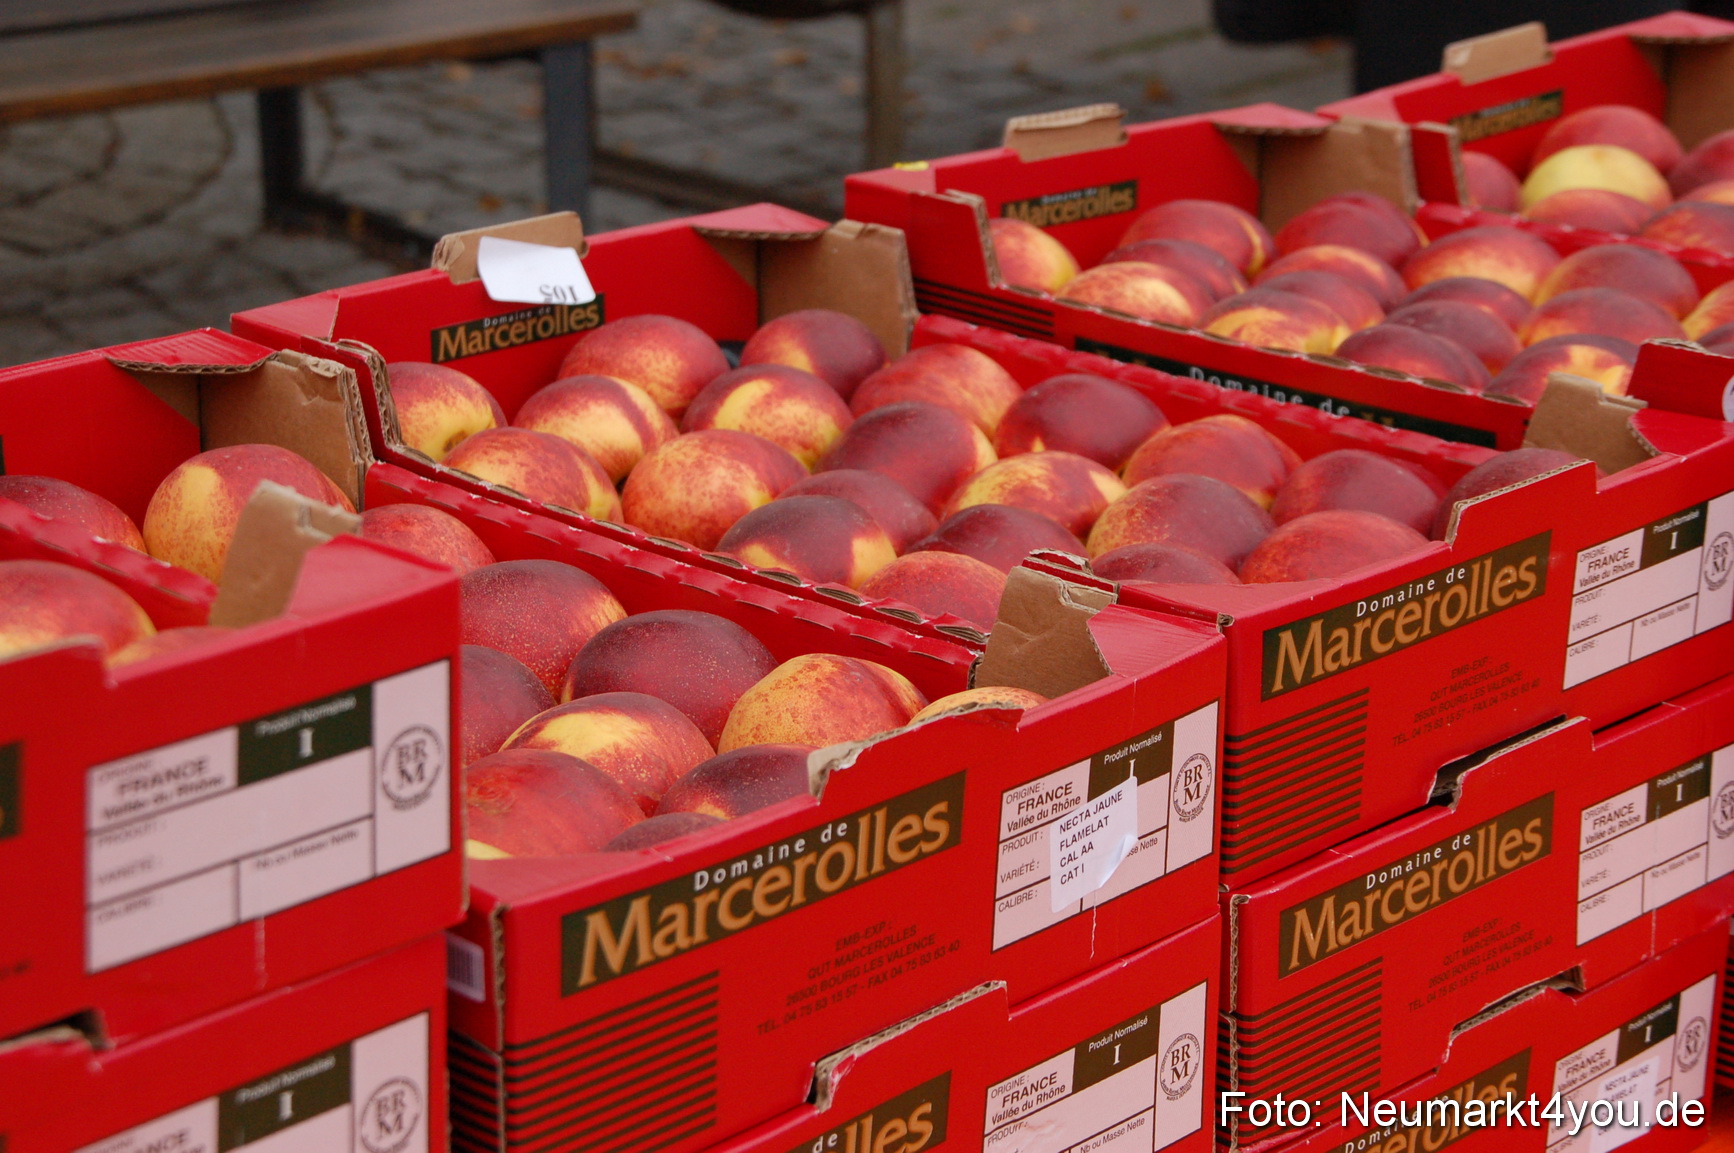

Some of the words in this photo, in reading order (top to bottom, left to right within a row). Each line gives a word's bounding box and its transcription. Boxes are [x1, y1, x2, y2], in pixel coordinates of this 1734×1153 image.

[438, 304, 600, 362] Marcerolles
[484, 311, 532, 328] Domaine
[1579, 573, 1600, 588] Vallée
[1602, 568, 1612, 581] du
[1612, 560, 1635, 576] Rhône
[1587, 547, 1630, 574] FRANCE
[1356, 578, 1436, 617] Domaine
[1446, 566, 1466, 584] de
[1271, 555, 1538, 693] Marcerolles
[1450, 662, 1511, 693] MARCEROLLES
[1104, 746, 1129, 765] Produit
[1129, 731, 1162, 754] Normalisé
[1183, 764, 1203, 788] BR
[1018, 782, 1073, 815] FRANCE
[1182, 781, 1202, 806] M
[1007, 815, 1034, 833] Vallée
[1036, 808, 1049, 821] du
[1051, 795, 1081, 815] Rhône
[1060, 809, 1091, 834] NECTA
[1093, 790, 1123, 815] JAUNE
[1592, 802, 1635, 830] FRANCE
[1060, 816, 1109, 851] FLAMELAT
[1140, 837, 1158, 850] Nette
[1607, 824, 1617, 836] du
[694, 837, 806, 891] Domaine
[820, 821, 848, 844] de
[1060, 852, 1078, 868] CAL
[1081, 841, 1094, 857] AA
[1366, 845, 1442, 890] Domaine
[1452, 833, 1471, 850] de
[1060, 867, 1080, 885] CAT
[578, 801, 949, 987] Marcerolles
[1288, 817, 1544, 970] Marcerolles
[807, 961, 831, 979] QUT
[834, 925, 917, 969] MARCEROLLES
[820, 968, 861, 995] BOURG
[863, 957, 884, 974] LES
[887, 933, 937, 964] VALENCE
[868, 971, 889, 989] FAX
[890, 965, 903, 979] 04
[1088, 1033, 1114, 1053] Produit
[1114, 1016, 1148, 1040] Normalisé
[1113, 1044, 1121, 1065] I
[1171, 1044, 1191, 1067] BR
[1565, 1048, 1607, 1078] FRANCE
[1170, 1060, 1190, 1085] M
[991, 1106, 1020, 1126] Vallée
[1021, 1098, 1034, 1112] du
[1036, 1084, 1066, 1105] Rhône
[1002, 1072, 1057, 1108] FRANCE
[812, 1133, 838, 1153] de
[1092, 1140, 1101, 1149] ou
[1102, 1128, 1126, 1144] Masse
[1126, 1117, 1145, 1133] Nette
